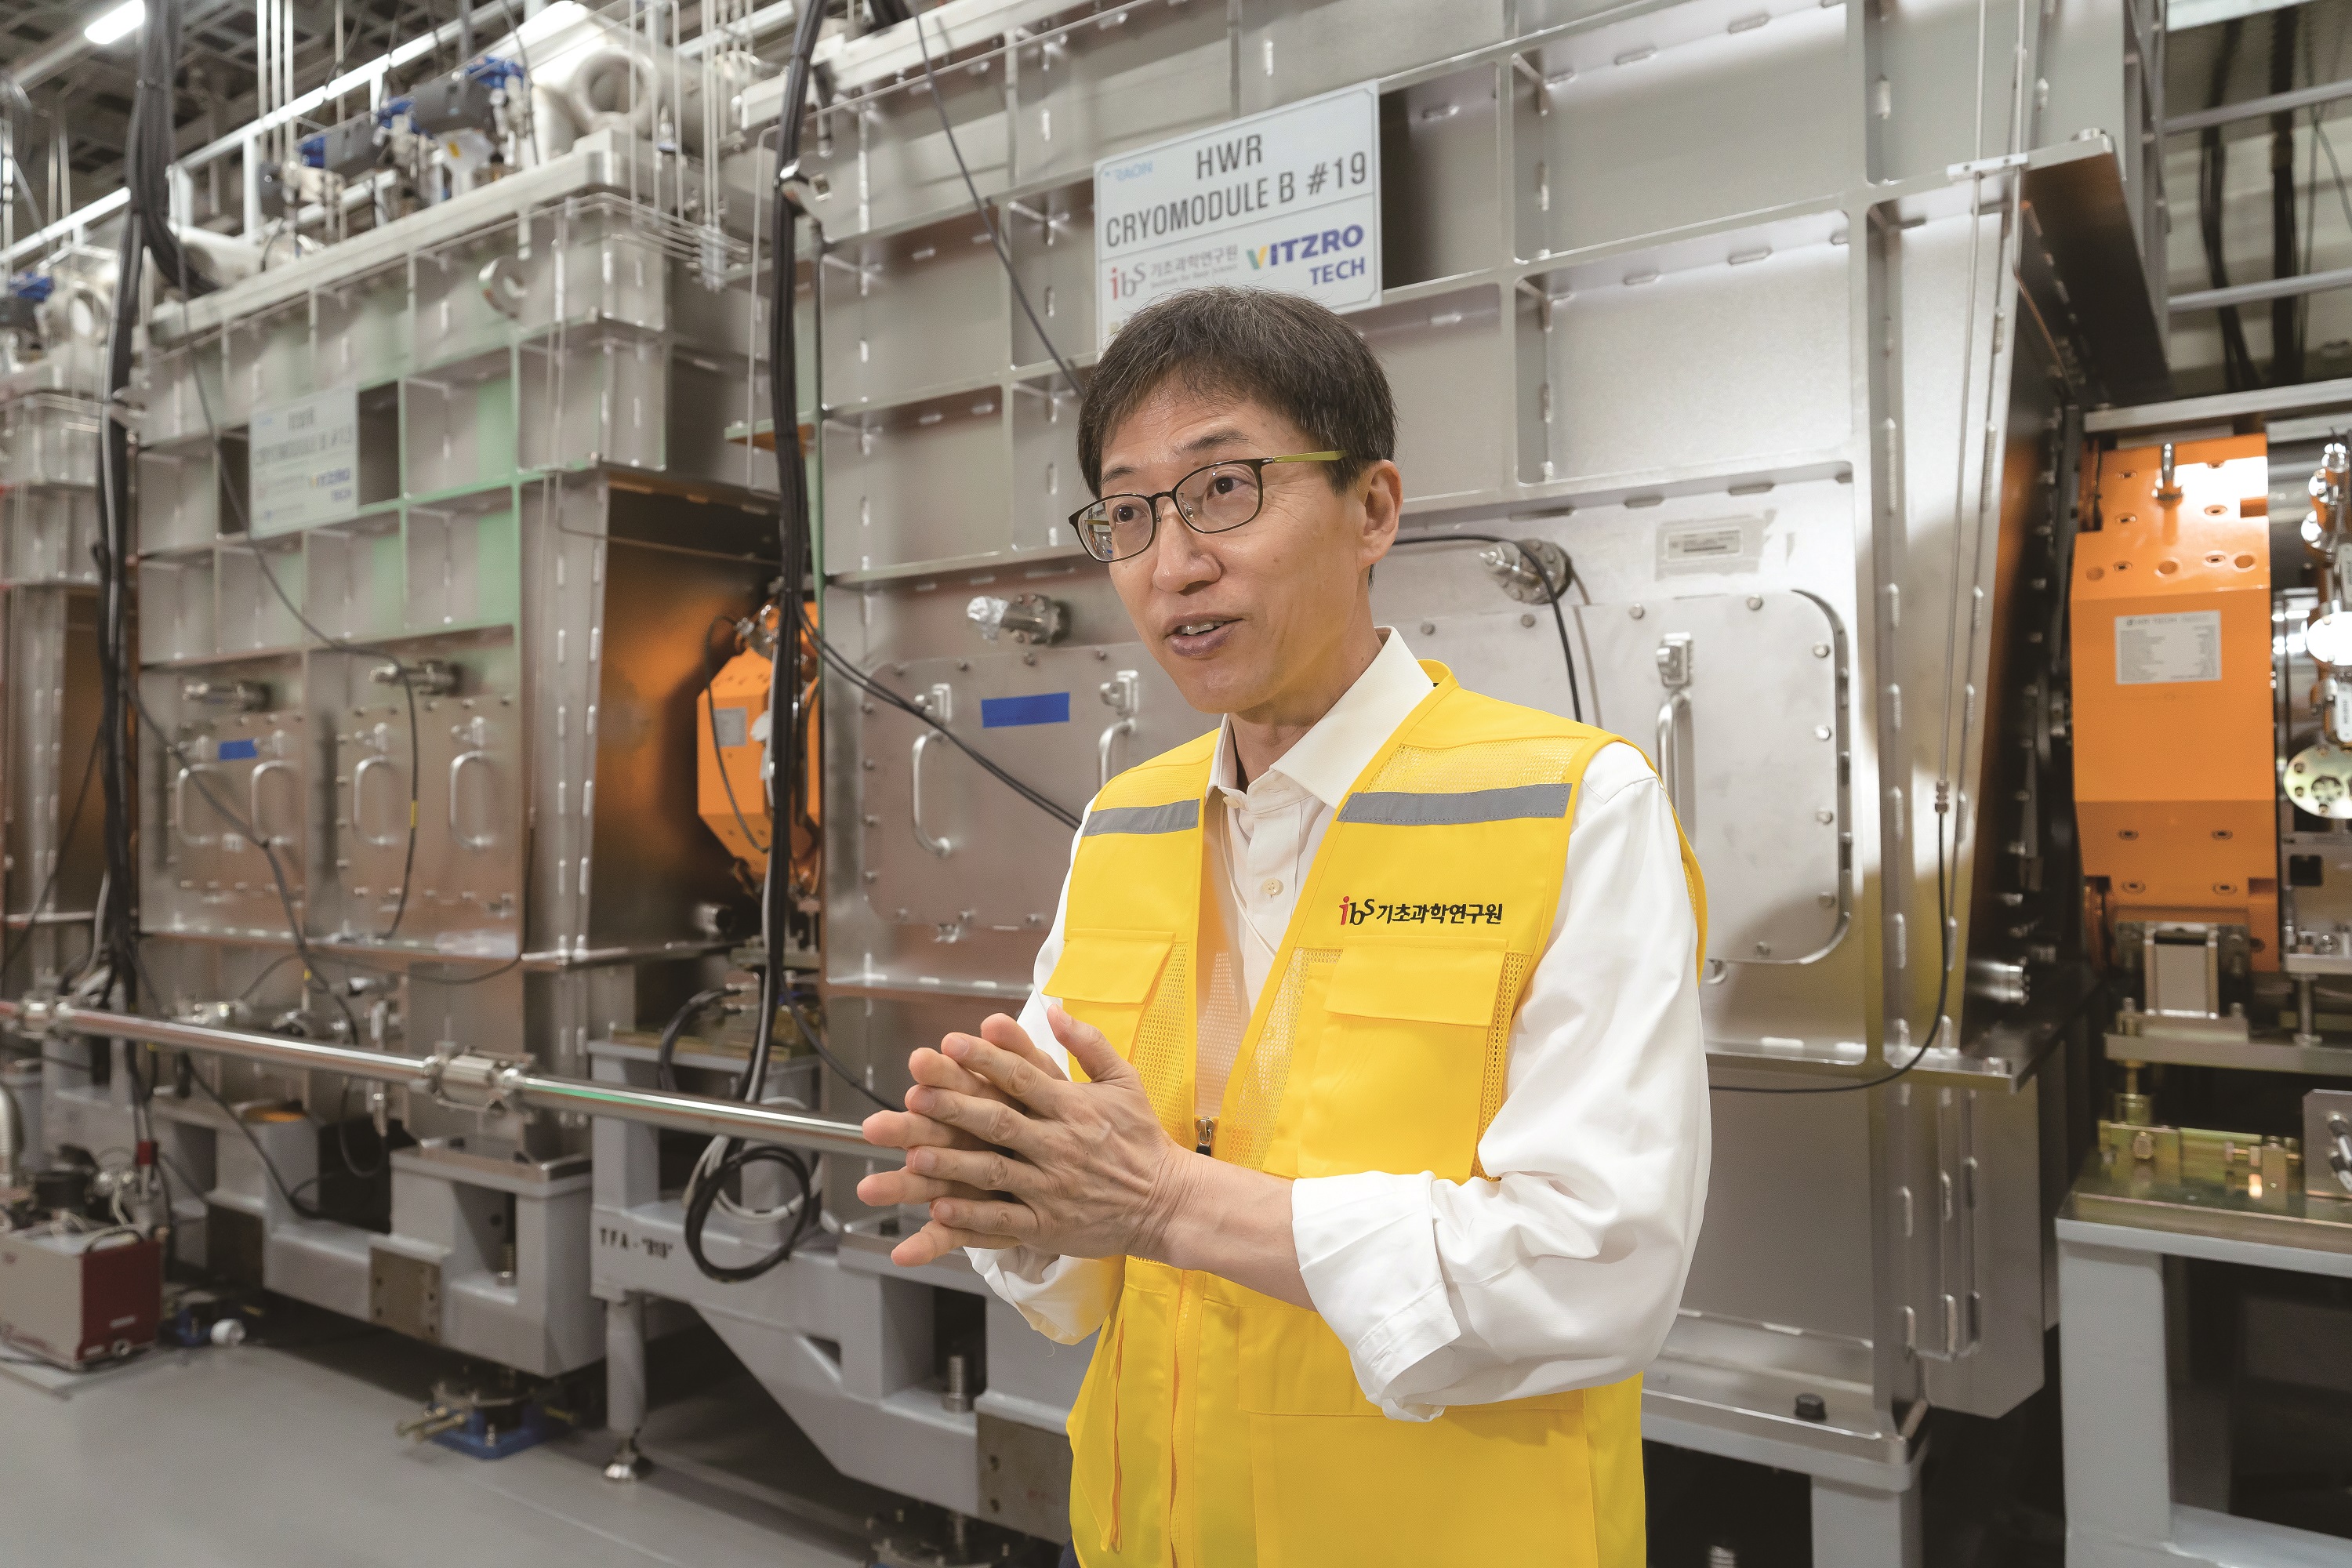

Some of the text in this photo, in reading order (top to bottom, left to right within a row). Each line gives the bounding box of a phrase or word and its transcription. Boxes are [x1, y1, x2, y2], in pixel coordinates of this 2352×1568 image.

[1196, 133, 1263, 180] HWR
[1105, 151, 1367, 249] CRYOMODULE B #19
[1246, 224, 1365, 270] VITZRO
[1309, 257, 1367, 286] TECH
[1376, 902, 1503, 925] 기초과학연구원
